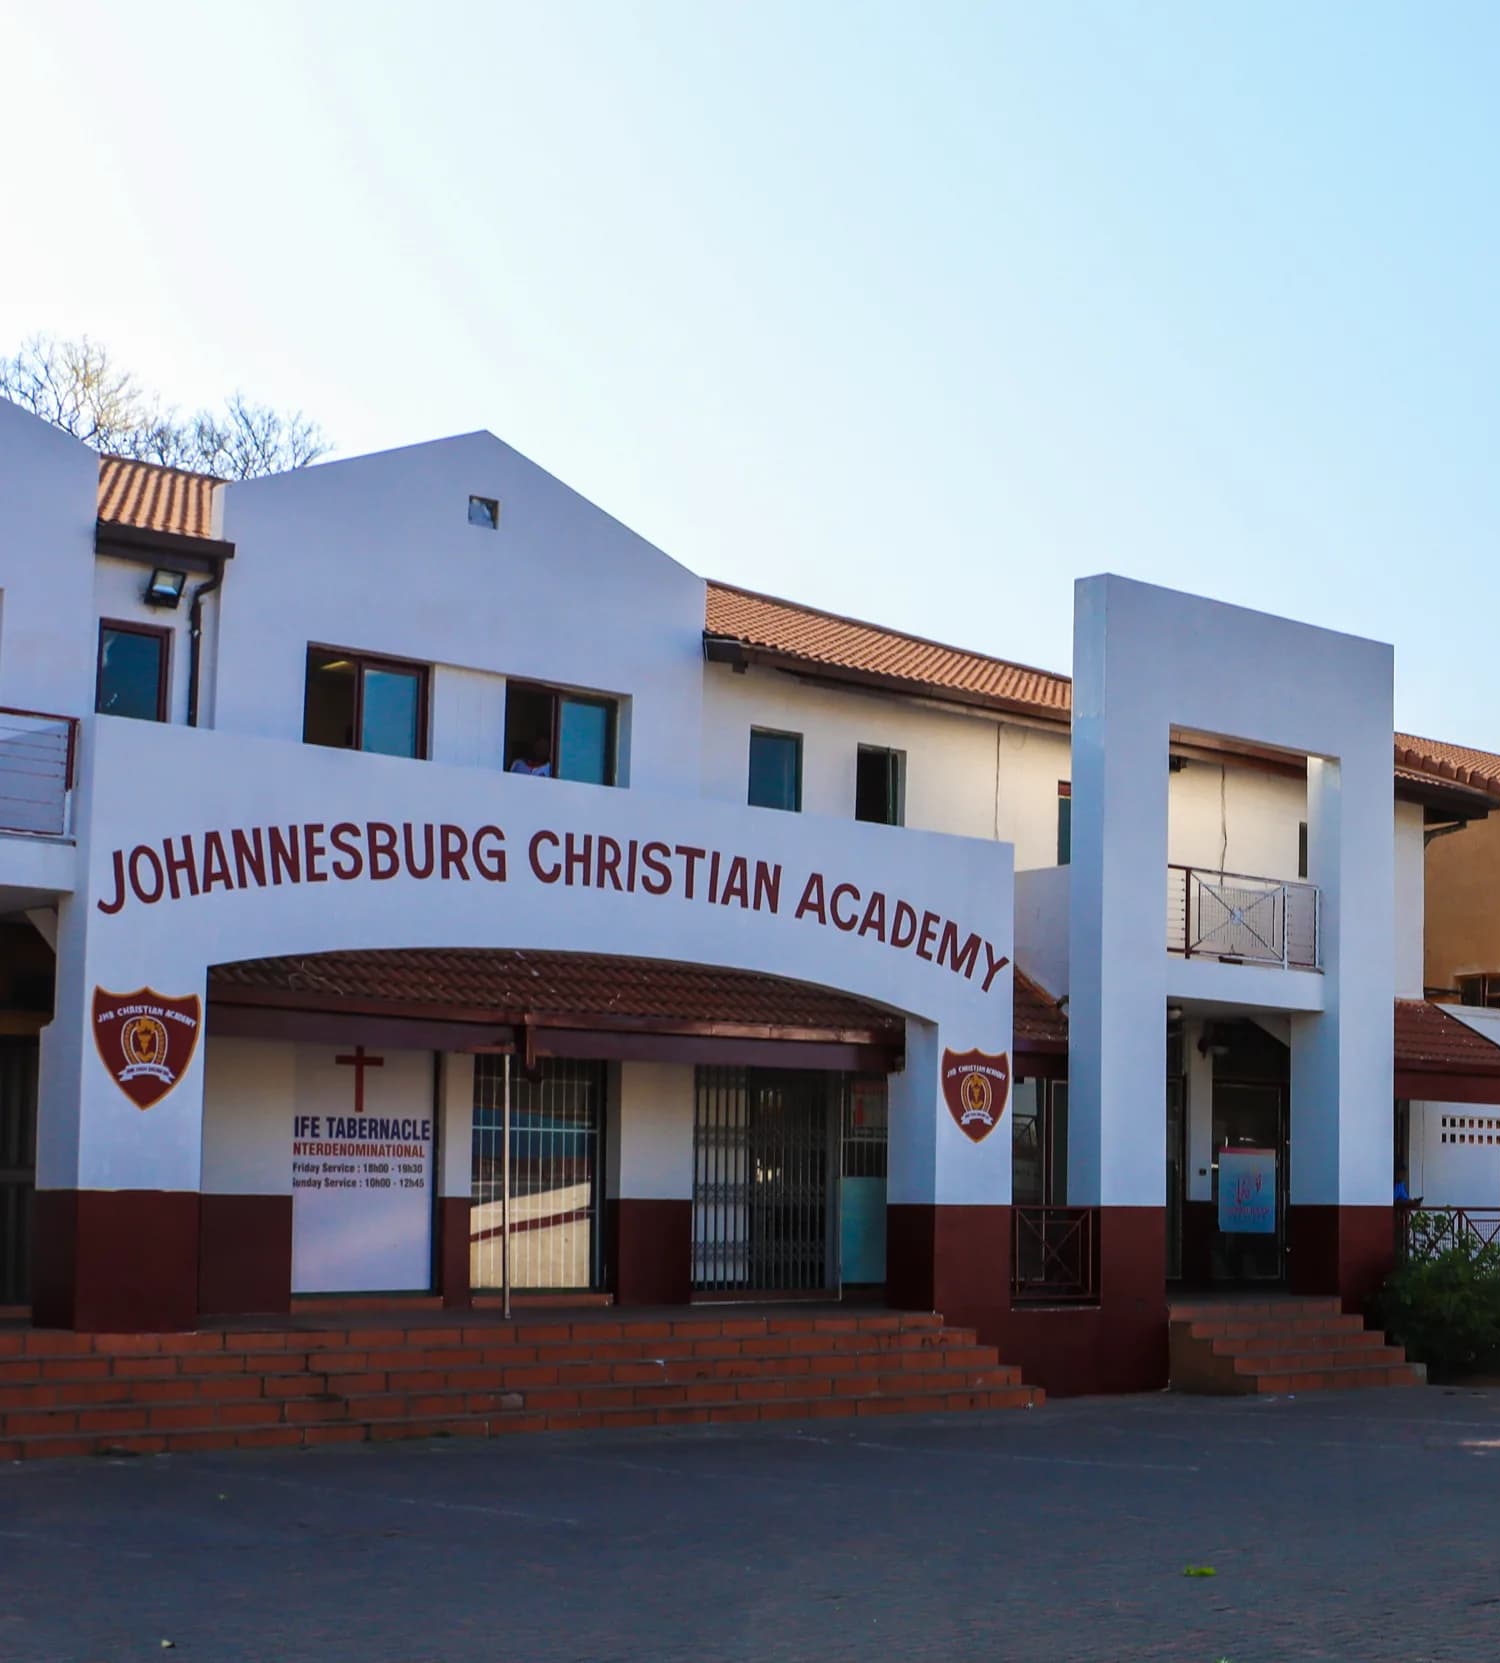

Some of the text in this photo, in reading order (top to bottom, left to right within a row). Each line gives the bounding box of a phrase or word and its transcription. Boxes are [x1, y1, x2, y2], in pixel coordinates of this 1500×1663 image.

[97, 823, 1010, 993] JOHANNESBURG CHRISTIAN ACADEMY
[117, 1005, 164, 1017] CHRISTIAN
[165, 1010, 197, 1028] ACADEMY
[294, 1116, 430, 1141] IFE TABERNACLE
[293, 1142, 425, 1158] NTERDENOMINATIONAL
[293, 1162, 320, 1174] Friday
[322, 1162, 355, 1173] Service
[363, 1163, 389, 1174] 18h00
[398, 1163, 423, 1174] 19h30
[324, 1177, 357, 1188] Service
[365, 1178, 391, 1188] 10h00
[400, 1178, 425, 1189] 12h45
